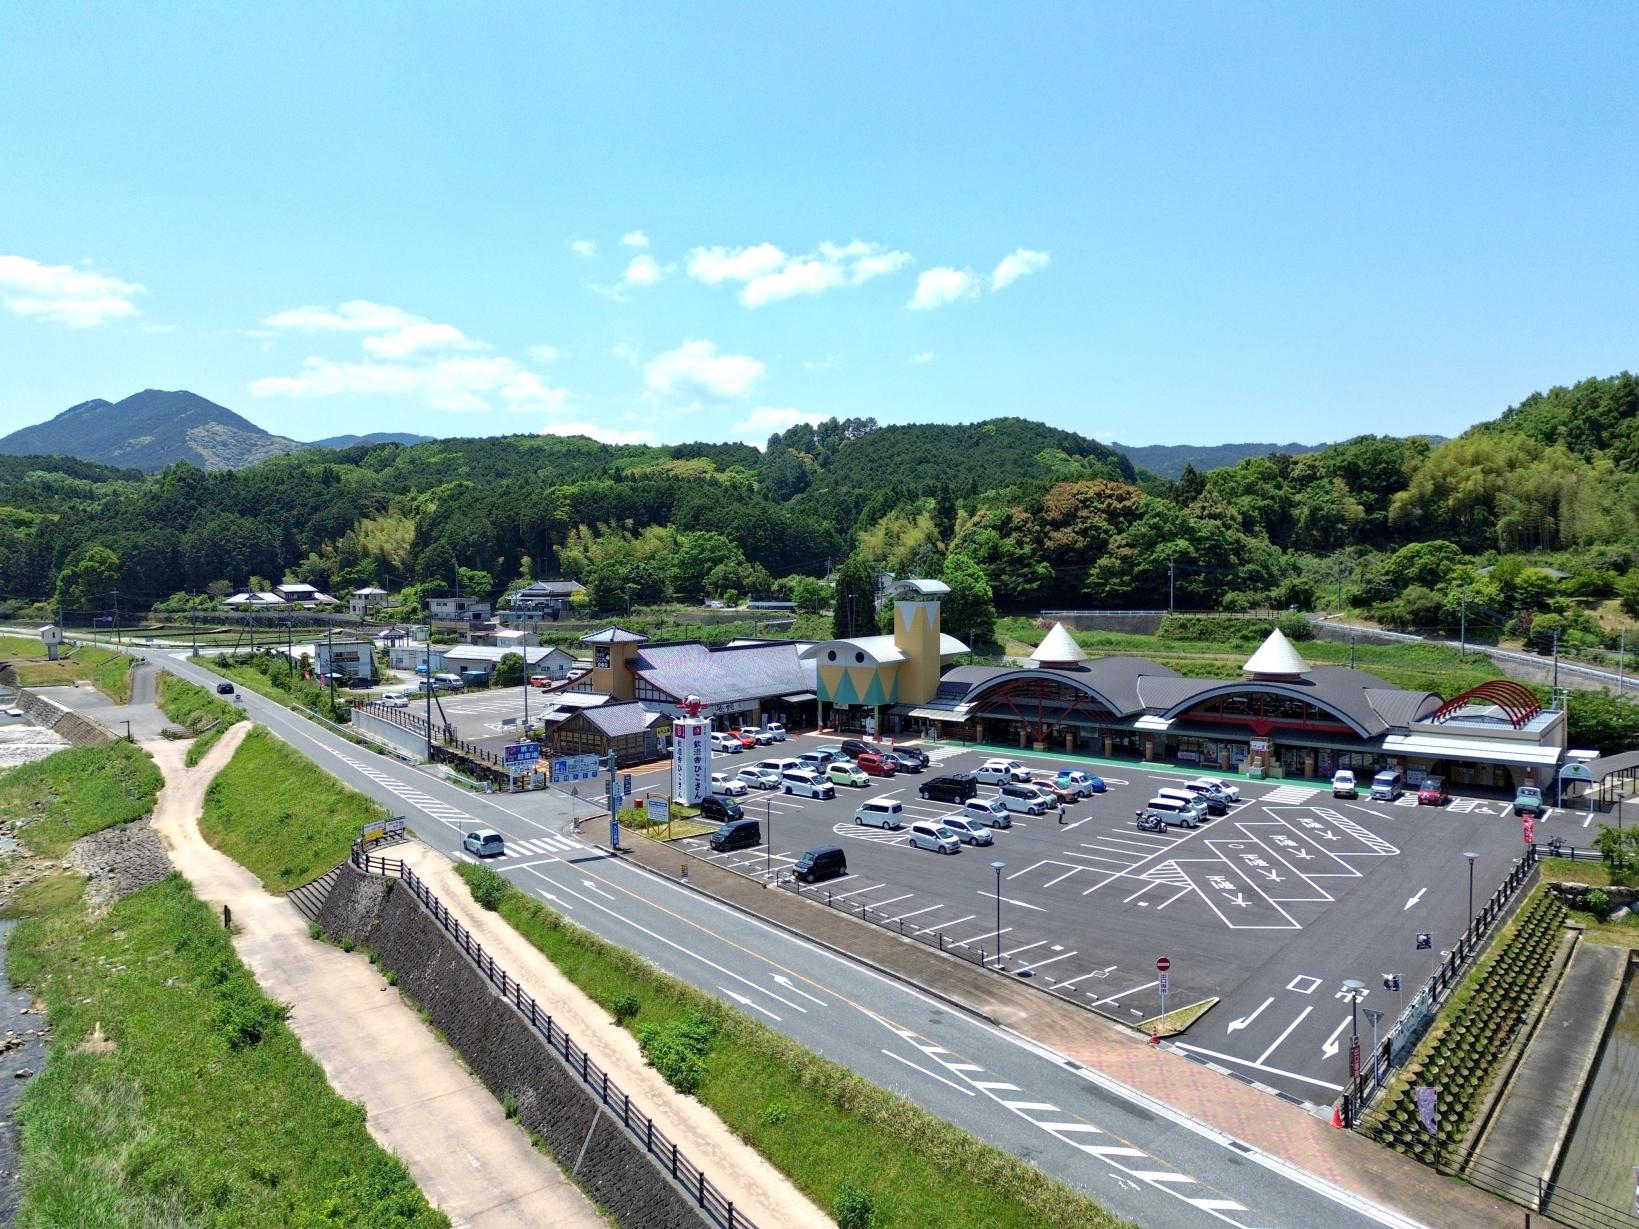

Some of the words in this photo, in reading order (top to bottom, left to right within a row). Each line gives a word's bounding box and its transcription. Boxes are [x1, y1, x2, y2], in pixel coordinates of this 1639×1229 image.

[1296, 818, 1342, 841] 大型
[1268, 835, 1316, 860] 大型
[1239, 853, 1287, 883] 大型
[1205, 875, 1253, 908] 大型
